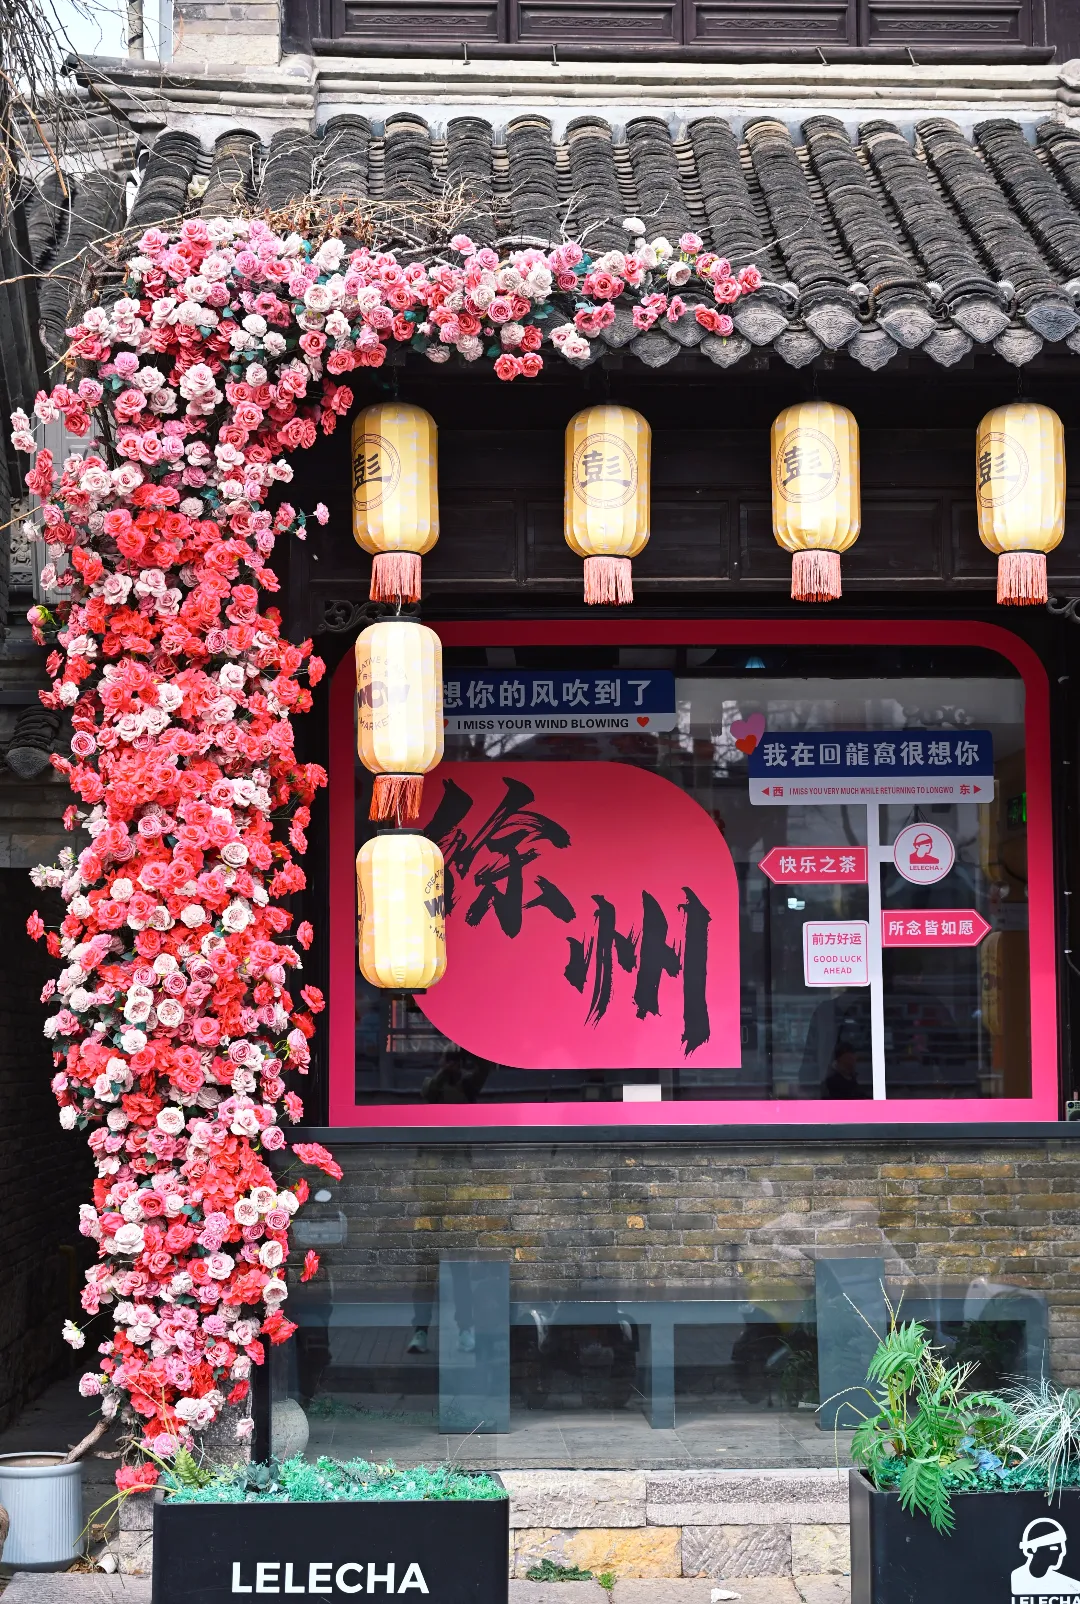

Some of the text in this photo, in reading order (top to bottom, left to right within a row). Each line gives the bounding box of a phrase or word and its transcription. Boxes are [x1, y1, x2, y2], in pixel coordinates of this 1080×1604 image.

[581, 449, 632, 488] 彭
[782, 446, 832, 486] 彭
[977, 451, 1017, 489] 彭
[357, 680, 410, 708] WOW
[443, 678, 652, 708] 想你的风吹到了
[457, 718, 629, 730] I MISS YOUR WIND BLOWING
[773, 786, 784, 797] 西
[840, 787, 859, 795] MUCH
[860, 787, 880, 795] WHILE
[880, 786, 916, 795] RETURNING
[916, 786, 926, 794] TO
[959, 784, 971, 796] 东
[779, 856, 857, 874] 快乐之茶
[423, 776, 712, 1060] 徐州
[888, 920, 974, 936] 所念皆如愿
[812, 933, 862, 945] 前方好运
[813, 955, 862, 963] GOOD LUCK
[231, 1562, 430, 1594] LELECHA
